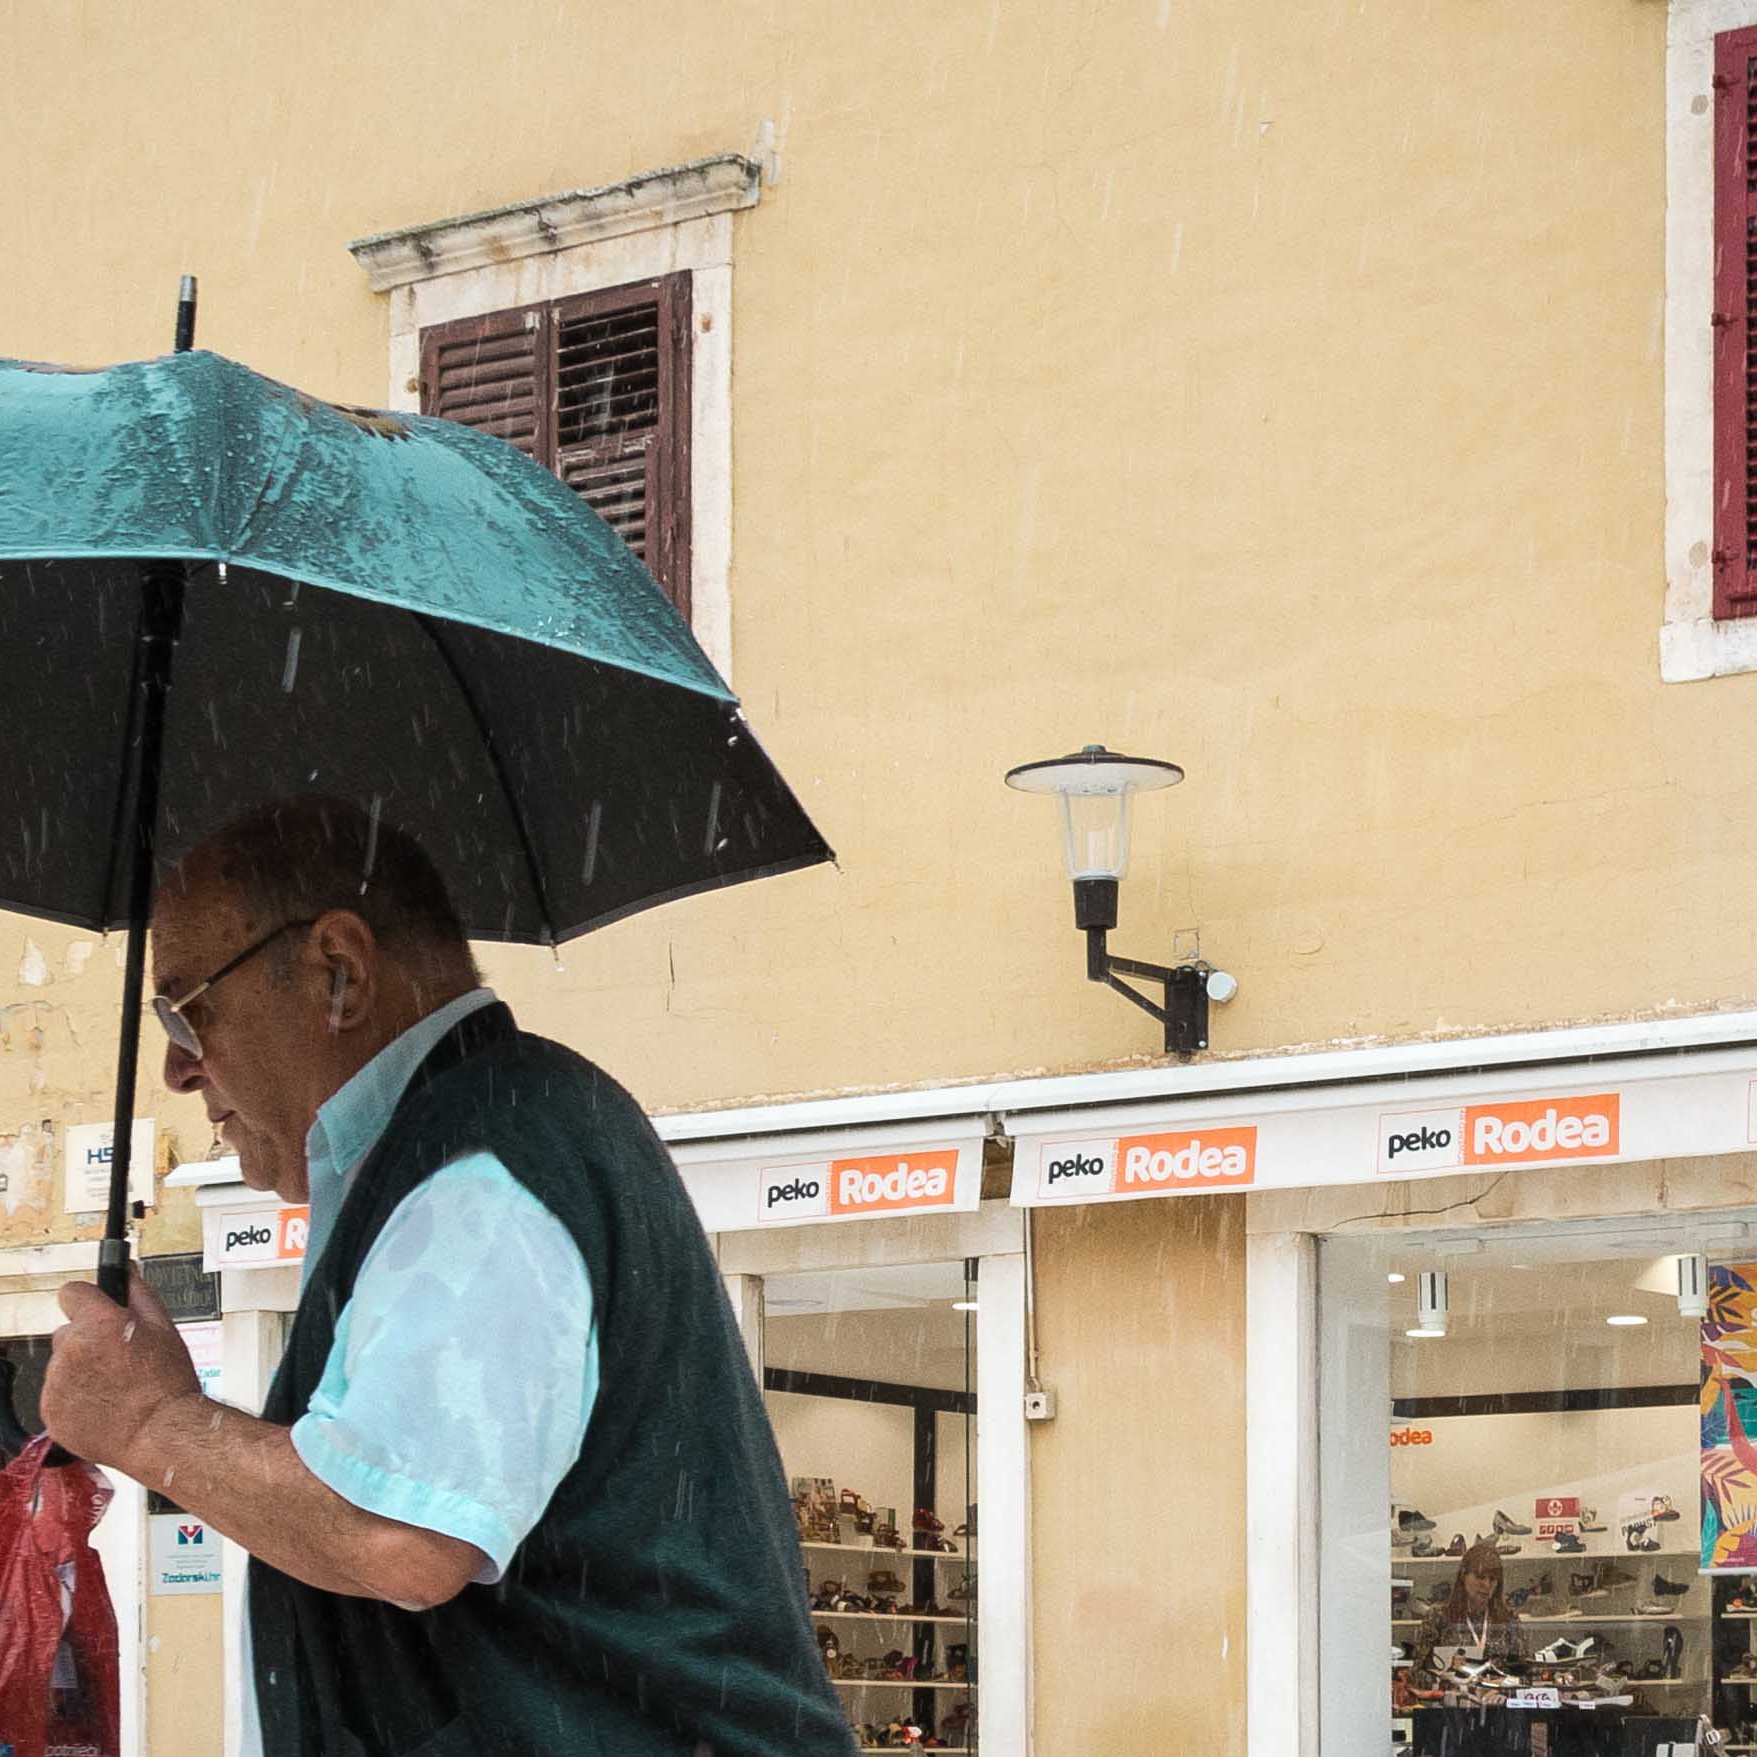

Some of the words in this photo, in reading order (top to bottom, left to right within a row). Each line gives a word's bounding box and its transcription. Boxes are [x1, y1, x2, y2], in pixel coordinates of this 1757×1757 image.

[1388, 1125, 1452, 1160] peko
[1474, 1112, 1610, 1155] Rodea
[1047, 1152, 1104, 1185] peko
[1124, 1138, 1247, 1184] Rodea
[767, 1177, 819, 1209] peko
[838, 1163, 947, 1206] Rodea
[225, 1225, 271, 1252] peko
[284, 1217, 309, 1250] R
